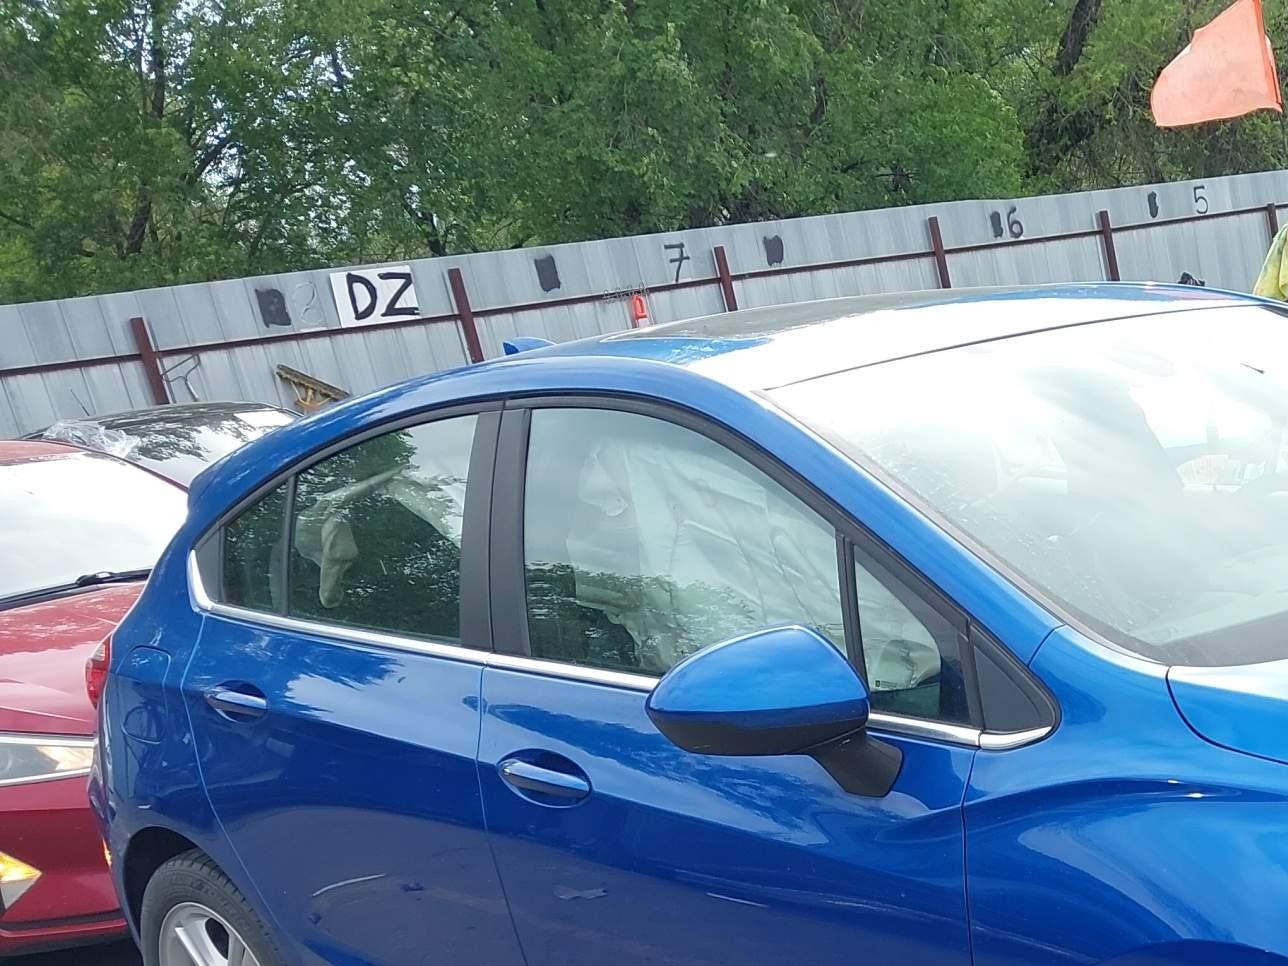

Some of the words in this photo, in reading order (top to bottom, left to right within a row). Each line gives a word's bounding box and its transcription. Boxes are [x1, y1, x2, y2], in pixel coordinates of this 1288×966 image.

[1193, 185, 1209, 214] 5
[1006, 205, 1024, 238] 6
[664, 243, 690, 282] 7
[346, 272, 420, 321] DZ
